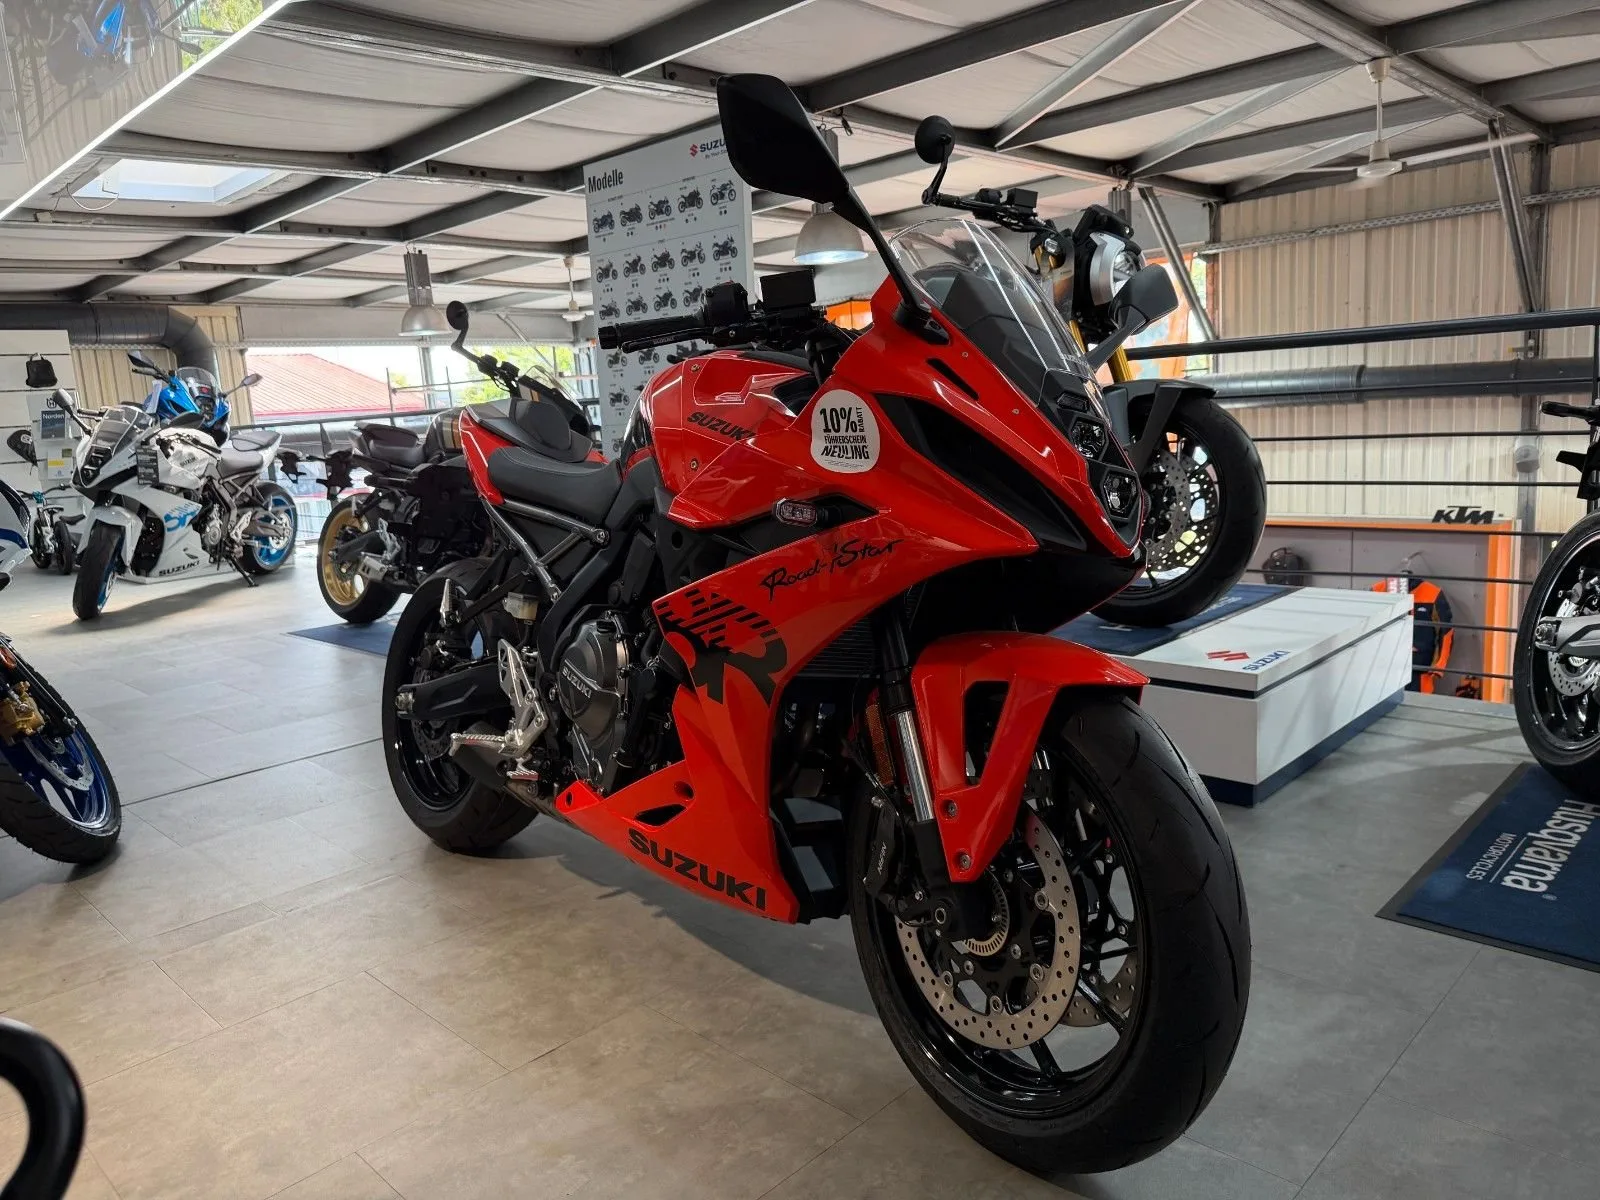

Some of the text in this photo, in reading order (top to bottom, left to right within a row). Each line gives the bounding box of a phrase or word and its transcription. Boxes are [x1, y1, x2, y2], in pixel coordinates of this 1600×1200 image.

[588, 169, 624, 194] Modelle
[687, 412, 757, 441] SUZUKI
[820, 407, 858, 433] 10%
[855, 406, 865, 433] RABATT
[824, 433, 868, 444] FÜHRERSCHEIN
[821, 444, 870, 460] NEULING
[1432, 506, 1494, 525] KTM
[159, 560, 200, 577] SUZUKI
[1242, 650, 1290, 671] SUZUKI
[562, 666, 592, 698] SUZUKI
[1465, 832, 1517, 880] MOTORCYCLES
[1500, 799, 1600, 892] Husqvarna
[628, 828, 766, 911] SUZUKI
